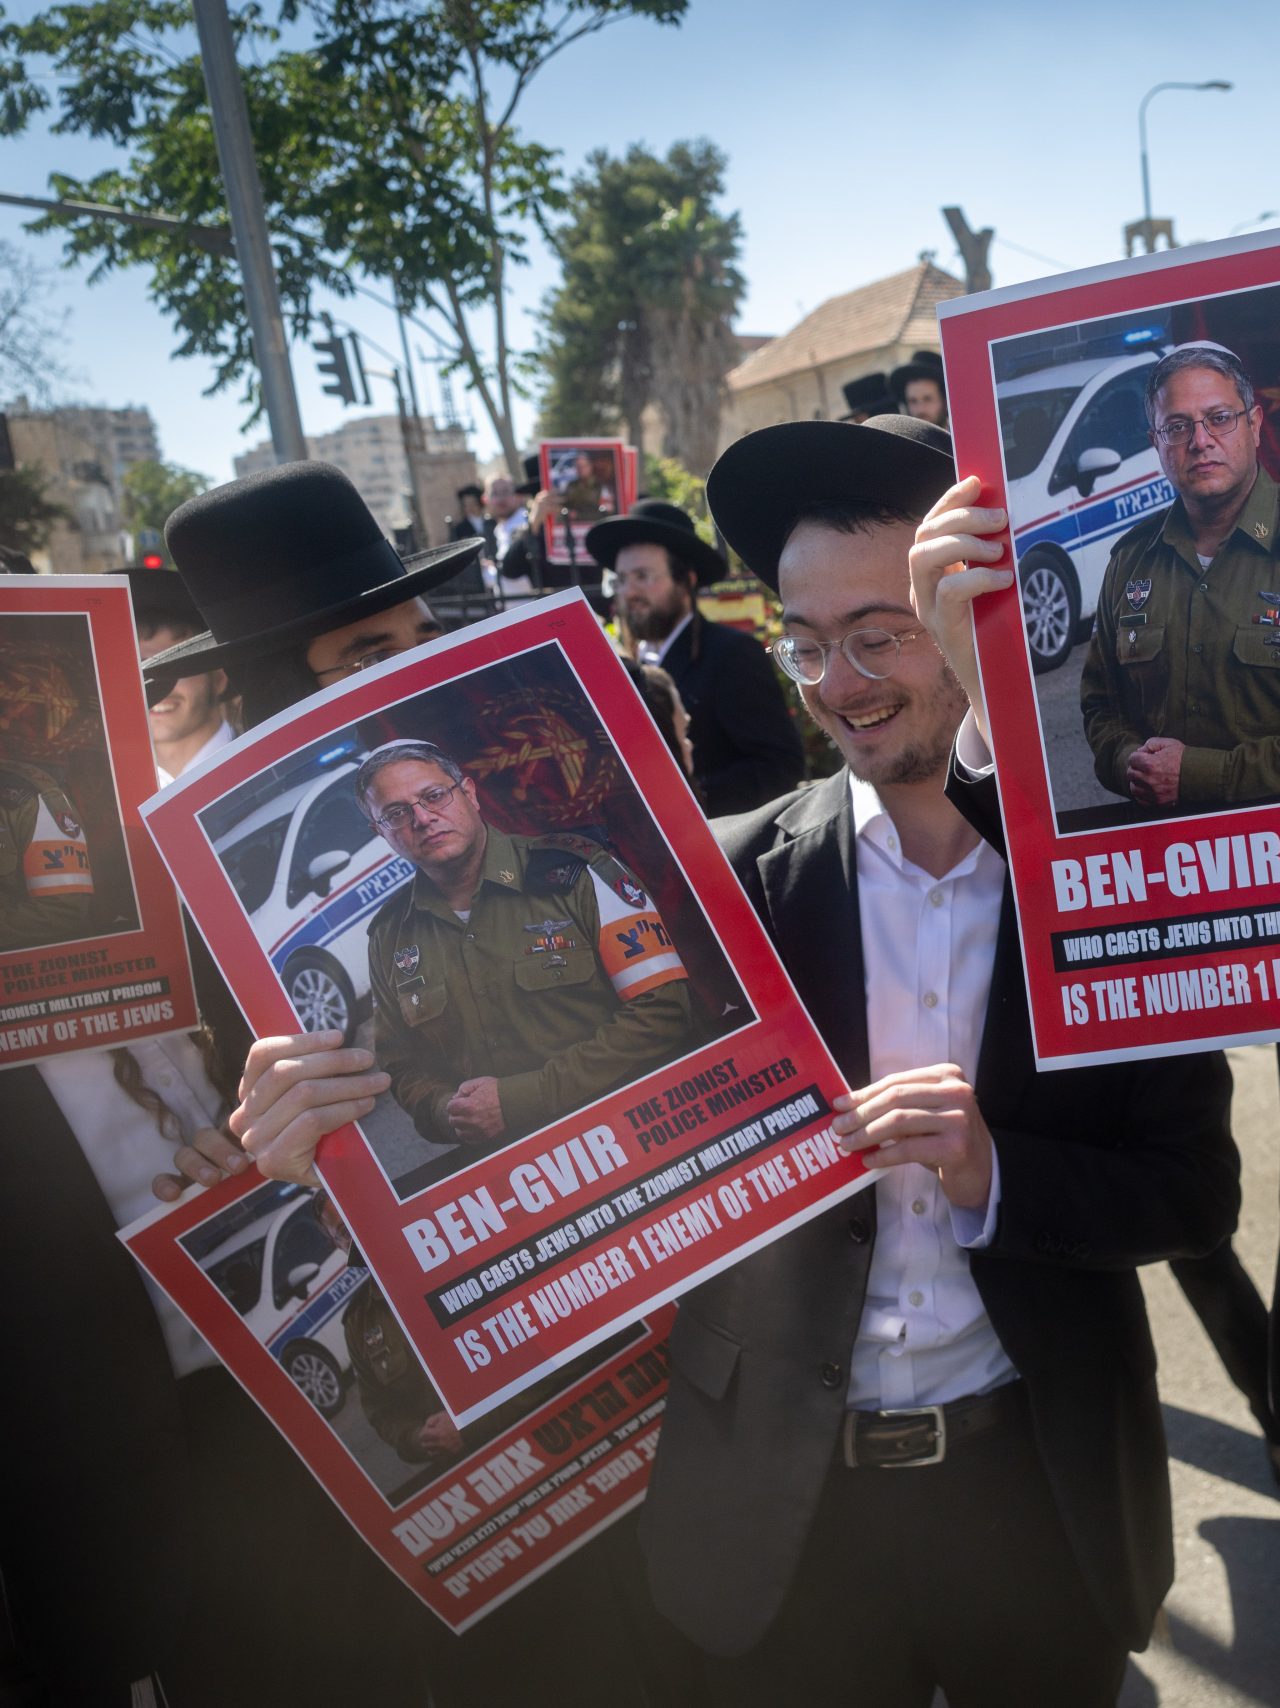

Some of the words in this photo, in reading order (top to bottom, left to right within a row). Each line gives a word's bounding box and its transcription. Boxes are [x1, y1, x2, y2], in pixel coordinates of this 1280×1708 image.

[1114, 479, 1176, 520] הצבאית
[356, 857, 414, 904] הצבאית
[616, 919, 673, 959] מ"צ
[1062, 935, 1104, 962] WHO
[1105, 927, 1161, 957] CASTS
[1163, 920, 1212, 949] JEWS
[1212, 915, 1253, 942] INTO
[2, 963, 34, 979] THE
[39, 949, 109, 973] ZIONIST
[4, 972, 68, 995] POLICE
[73, 956, 156, 983] MINISTER
[49, 990, 110, 1012] MILITARY
[112, 980, 162, 1001] PRISON
[1061, 983, 1090, 1026] IS
[1091, 976, 1141, 1022] THE
[1142, 963, 1252, 1016] NUMBER
[1253, 960, 1270, 1001] 1
[53, 1019, 79, 1041] OF
[80, 1011, 120, 1036] THE
[123, 1000, 175, 1028] JEWS
[623, 1102, 666, 1130] THE
[662, 1057, 739, 1112] ZIONIST
[635, 1107, 708, 1153] POLICE
[707, 1056, 798, 1118] MINISTER
[401, 1124, 629, 1271] BEN-GVIR
[439, 1277, 484, 1315] WHO
[479, 1248, 536, 1292] CASTS
[535, 1223, 581, 1263] JEWS
[575, 1203, 616, 1239] INTO
[611, 1189, 646, 1218] THE
[640, 1156, 702, 1202] ZIONIST
[697, 1120, 767, 1172] MILITARY
[762, 1093, 820, 1136] PRISON
[453, 1329, 492, 1374] IS
[481, 1300, 540, 1355] THE
[528, 1246, 636, 1329] NUMBER
[627, 1235, 651, 1271] 1
[641, 1191, 723, 1264] ENEMY
[717, 1177, 753, 1220] OF
[745, 1154, 798, 1204] THE
[531, 1379, 629, 1455] הראש
[465, 1438, 546, 1505] אתה
[587, 1449, 644, 1494] מספר
[391, 1483, 481, 1557] אשם
[545, 1484, 595, 1526] אחת
[512, 1514, 551, 1547] של
[443, 1536, 523, 1598] היהודים
